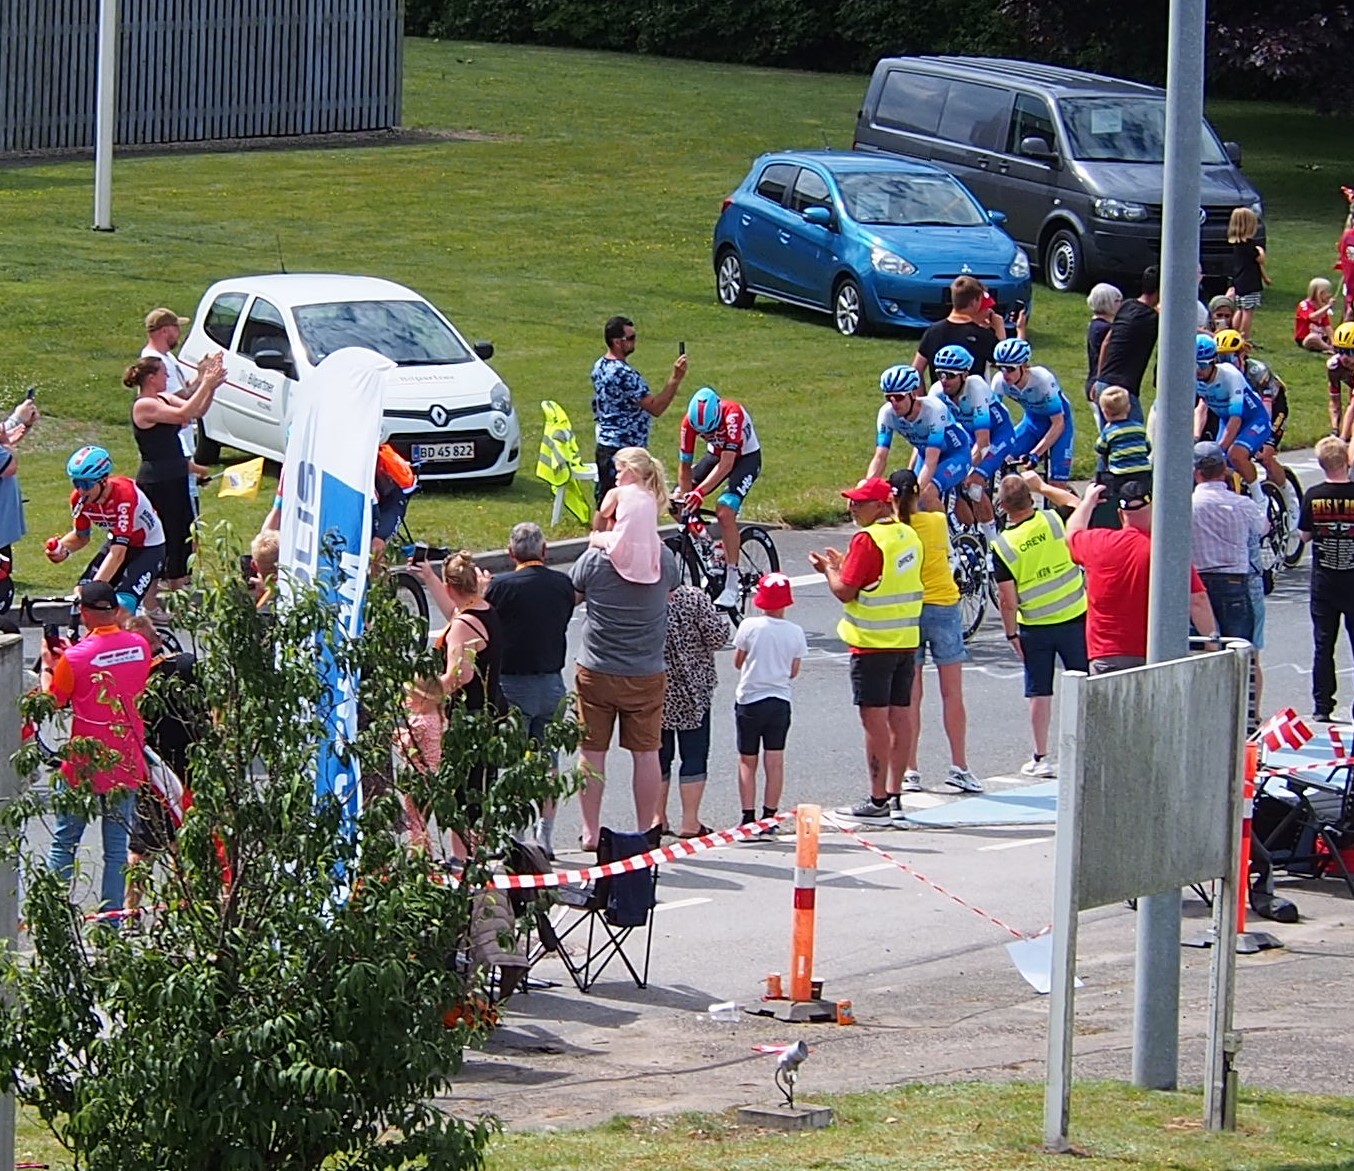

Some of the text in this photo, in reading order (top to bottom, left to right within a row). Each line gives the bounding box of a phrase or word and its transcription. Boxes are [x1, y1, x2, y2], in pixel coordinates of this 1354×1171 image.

[725, 413, 740, 440] lotto
[420, 445, 473, 458] BD 45 822
[117, 502, 131, 533] lotto
[1019, 532, 1047, 553] CREW
[132, 571, 152, 596] lotto
